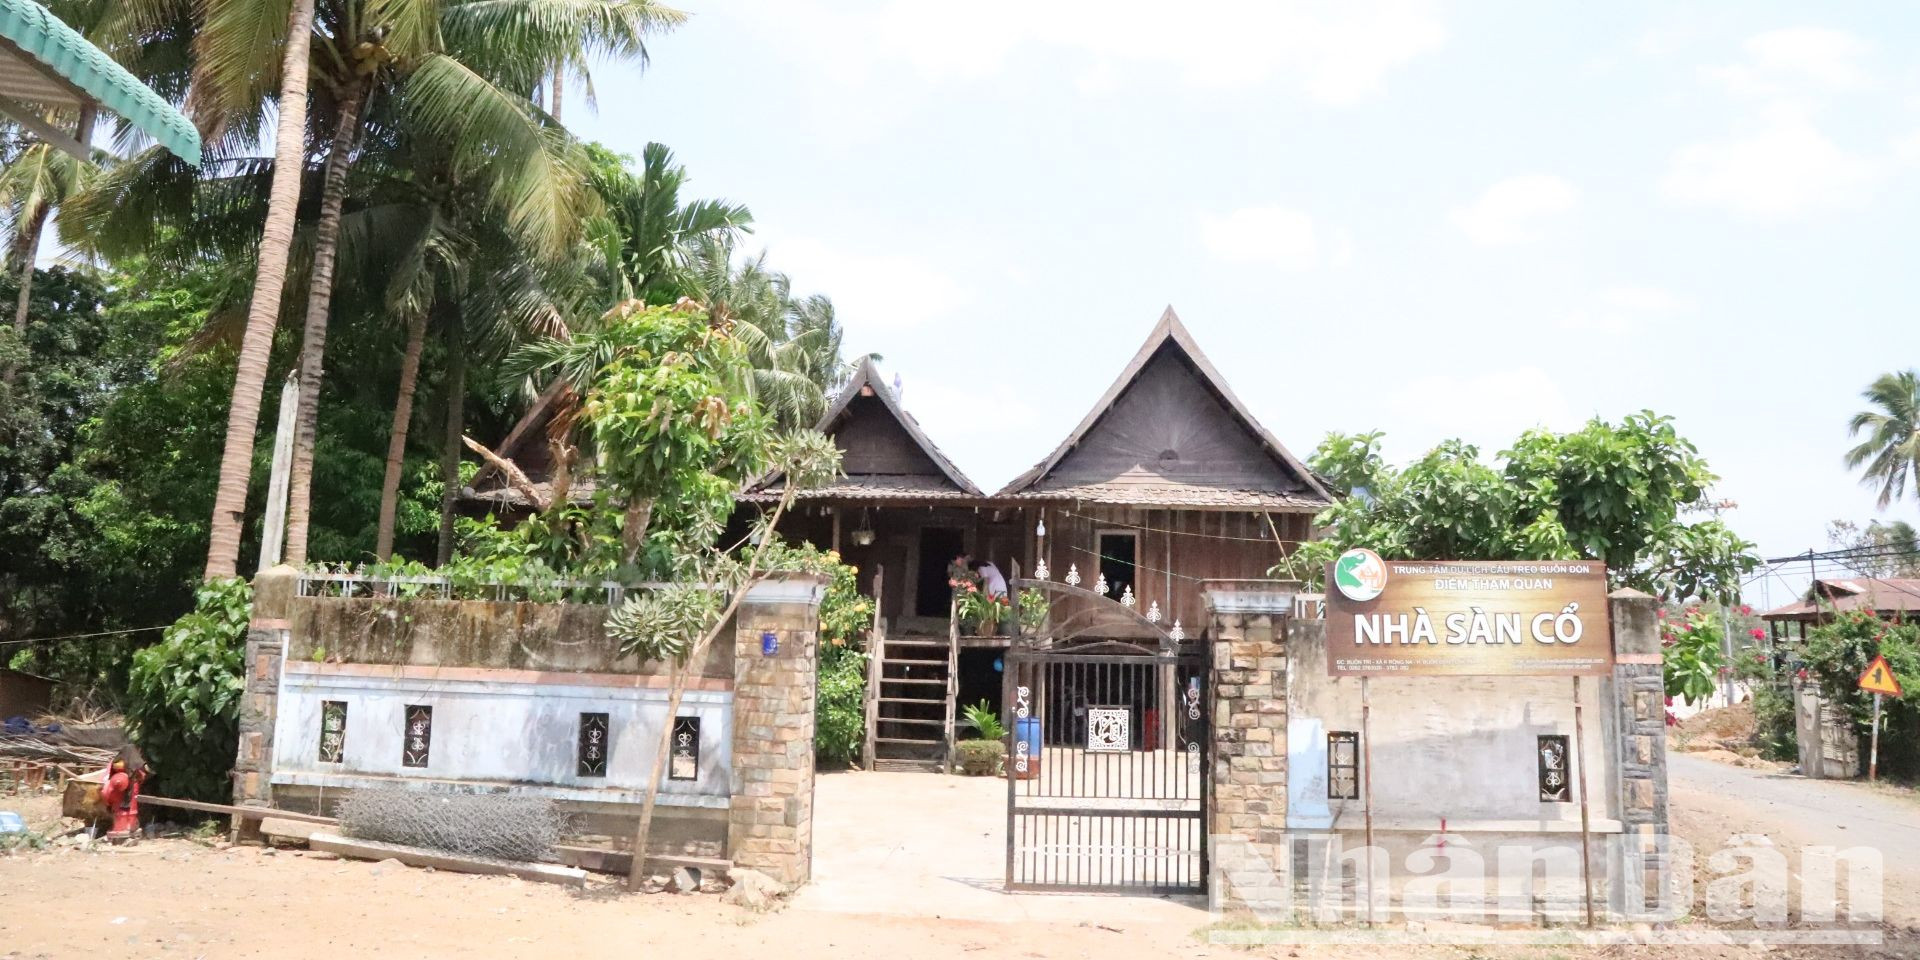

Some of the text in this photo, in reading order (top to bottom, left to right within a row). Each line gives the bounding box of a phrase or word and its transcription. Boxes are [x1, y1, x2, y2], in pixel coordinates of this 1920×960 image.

[1393, 566, 1426, 574] TRUNG
[1428, 564, 1448, 574] TÂM
[1450, 566, 1464, 574] DU
[1466, 566, 1488, 576] LỊCH
[1511, 565, 1538, 574] TREO
[1540, 563, 1567, 574] BUÔN
[1471, 579, 1510, 590] THAM
[1513, 578, 1553, 590] QUAN
[1354, 601, 1584, 645] NHÀ SÀN CỔ
